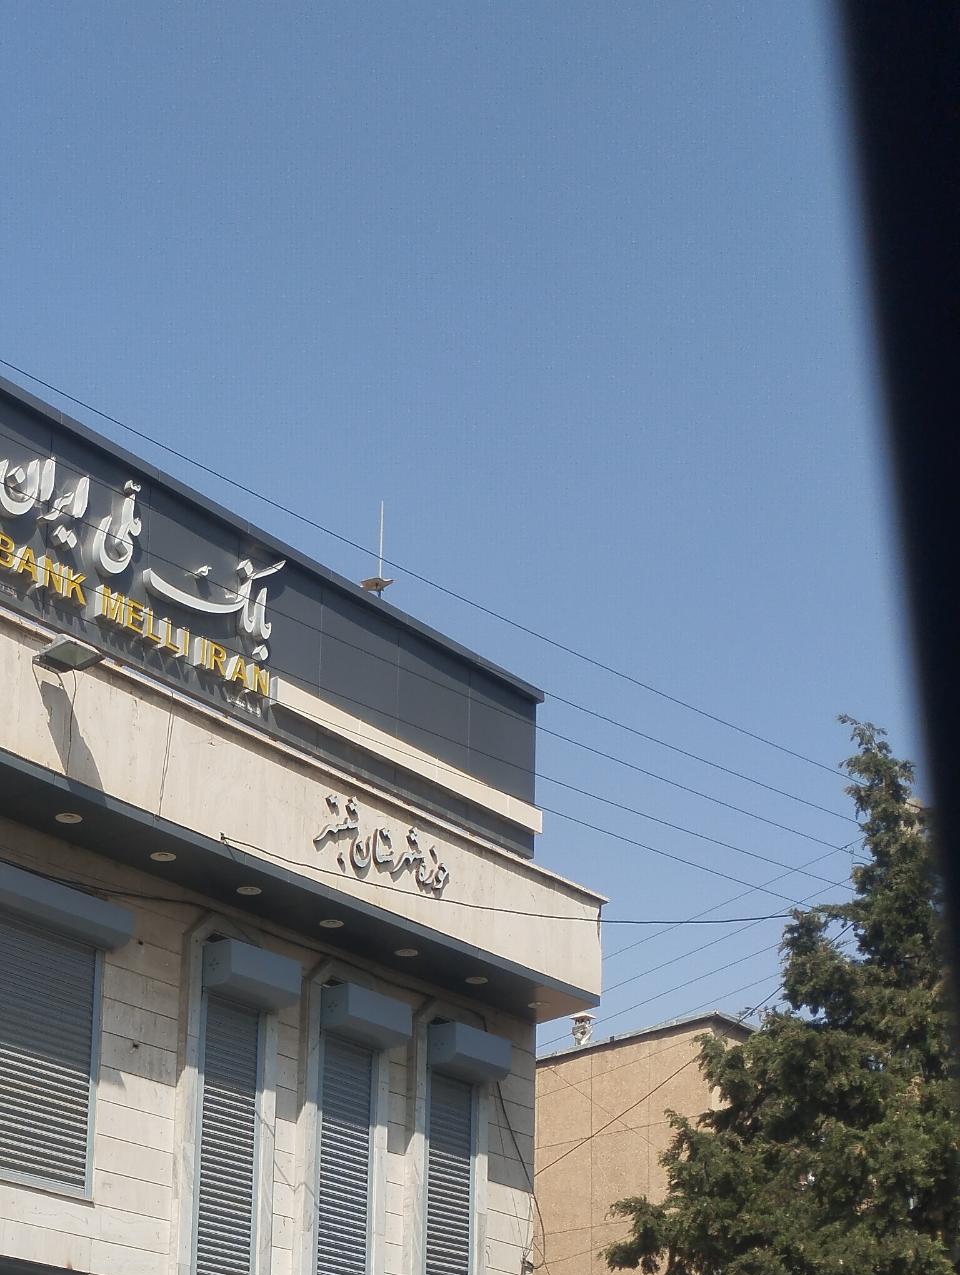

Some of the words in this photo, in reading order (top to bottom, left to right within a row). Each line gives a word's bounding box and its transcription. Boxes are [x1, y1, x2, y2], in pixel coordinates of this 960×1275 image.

[93, 479, 142, 574] ملی
[97, 584, 190, 658] MELLI
[197, 637, 270, 697] IRAN
[143, 558, 287, 661] بانک
[349, 824, 426, 874] شهرستان
